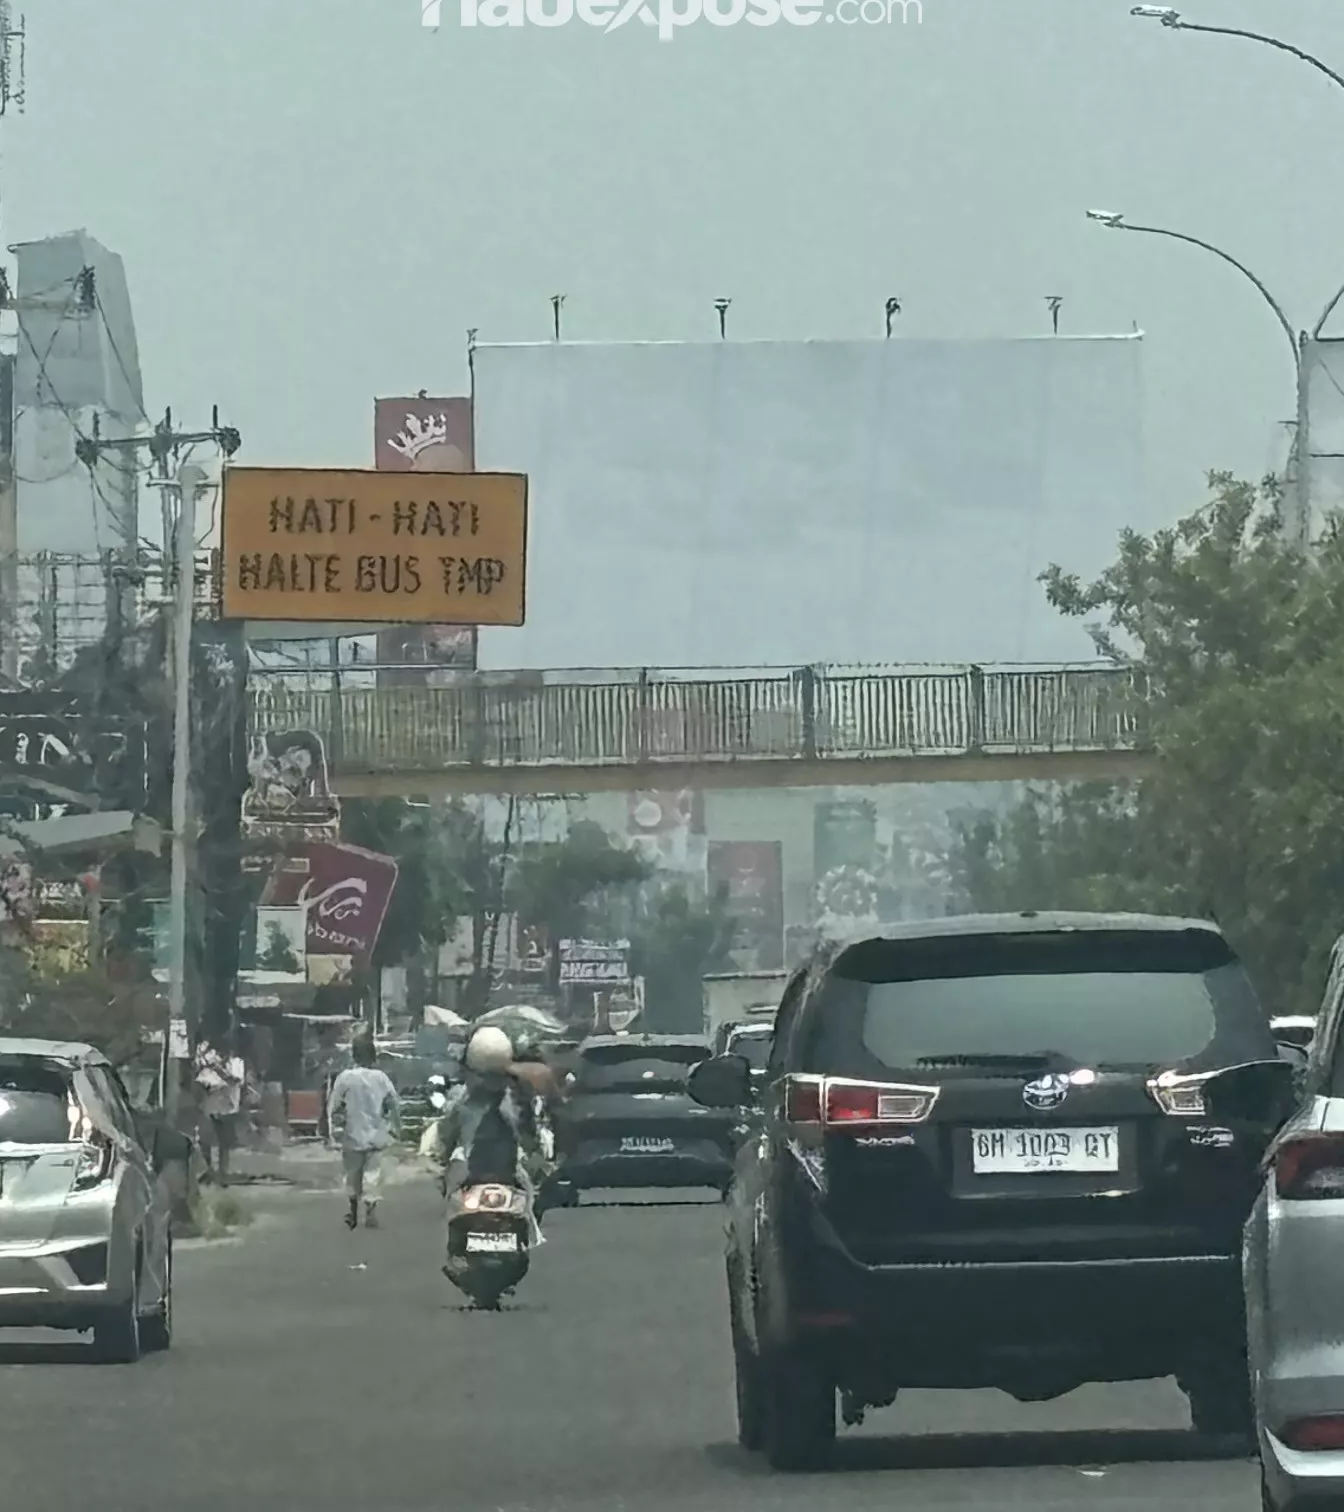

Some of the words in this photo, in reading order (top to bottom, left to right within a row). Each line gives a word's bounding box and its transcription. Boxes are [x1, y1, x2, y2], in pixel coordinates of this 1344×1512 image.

[269, 496, 355, 534] HATI
[392, 499, 479, 536] HATI
[238, 552, 341, 593] HALTE
[355, 554, 421, 594] BUS
